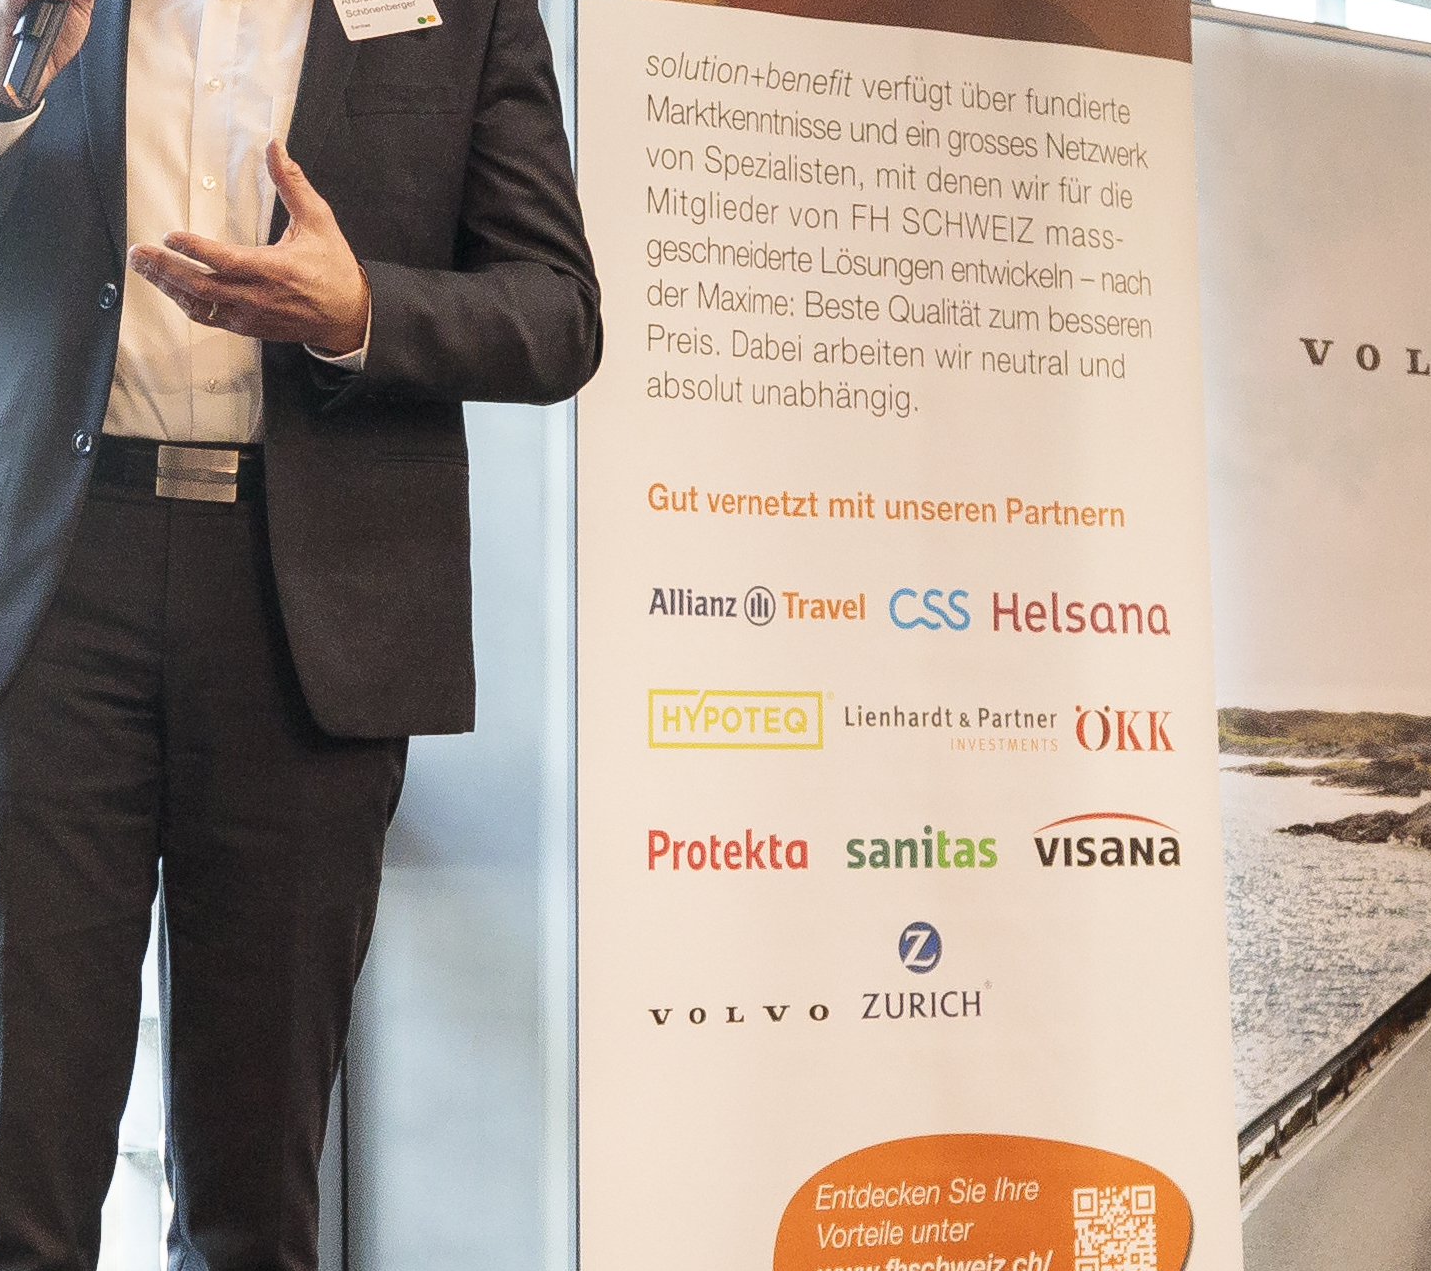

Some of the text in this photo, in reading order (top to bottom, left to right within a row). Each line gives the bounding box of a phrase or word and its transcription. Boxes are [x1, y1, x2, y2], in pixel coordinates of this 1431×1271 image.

[345, 0, 416, 18] Schönenberger
[645, 52, 1130, 125] solution+benefit verfügt über fundierte
[646, 94, 1148, 169] Marktkenntnisse und ein grosses Netzwerk
[646, 145, 1133, 210] von Spezialisten, mit denen wir für die
[647, 185, 1123, 250] Mitglieder von FH SCHWEIZ mass-
[646, 236, 813, 273] geschneiderte
[821, 246, 944, 286] Lösungen
[951, 259, 1073, 289] entwickeln
[1101, 270, 1151, 296] nach
[646, 279, 1152, 338] der Maxime: Beste Qualität zum besseren
[647, 323, 1125, 379] Preis. Dabei arbeiten wir neutral und
[646, 371, 918, 419] absolut unabhängig.
[647, 482, 1125, 527] Gut vernetzt mit unseren Partnern
[648, 587, 866, 620] Allianz Travel
[888, 587, 971, 632] CSS
[992, 591, 1171, 636] Helsana
[663, 706, 807, 733] HYPOTEQ
[844, 704, 1057, 729] Lienhardt & Partner
[1075, 704, 1175, 752] ÖKK
[951, 738, 1057, 751] INVESTMENTS
[647, 828, 809, 871] Protekta
[845, 824, 998, 870] sanitas
[647, 1003, 830, 1026] VOLVO
[861, 990, 982, 1020] ZURICH
[816, 1177, 1039, 1210] Entdecken Sie Ihre
[818, 1219, 974, 1248] Vorteile unter
